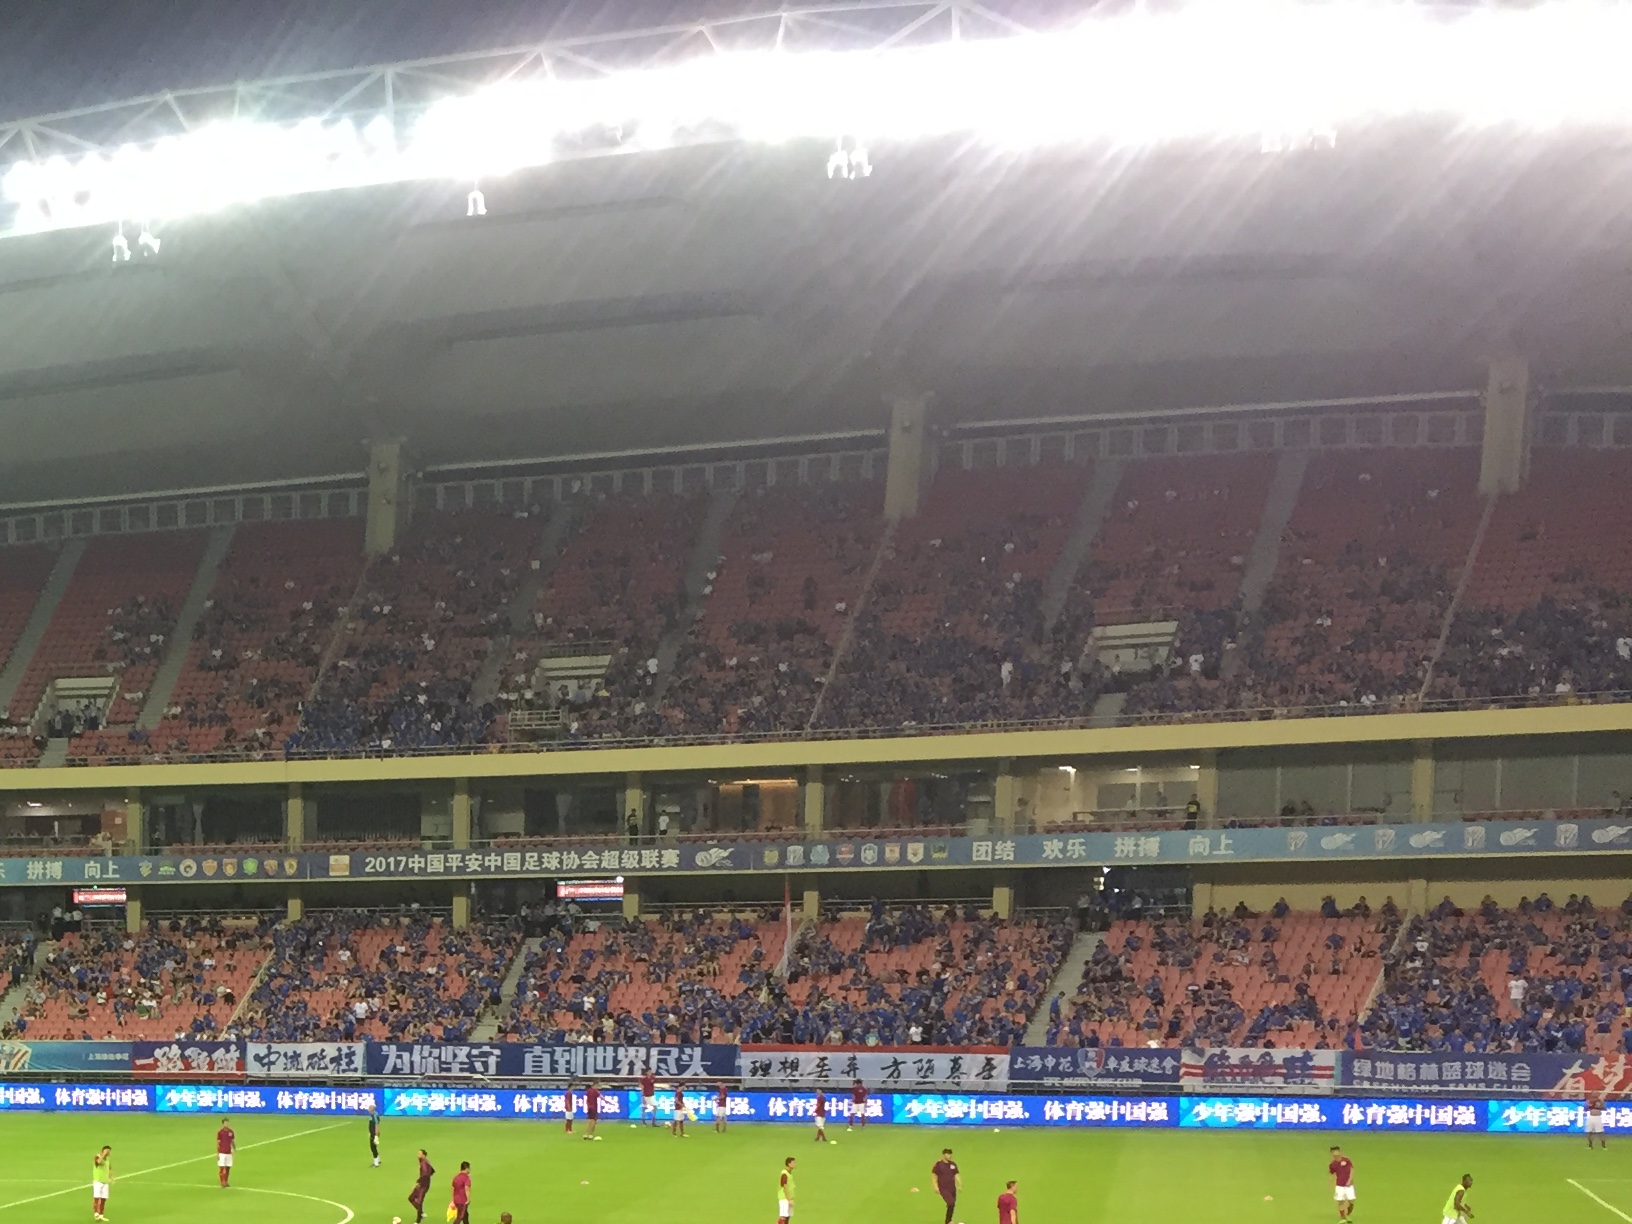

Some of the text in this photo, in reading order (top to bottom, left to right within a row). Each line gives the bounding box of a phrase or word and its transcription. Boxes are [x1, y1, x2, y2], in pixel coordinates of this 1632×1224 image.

[972, 834, 1234, 862] 团结 欢乐 拼搏 向上
[27, 860, 62, 880] 拼搏
[85, 860, 119, 880] 向上
[365, 849, 679, 873] 2017中国平安中国足球协会超级联赛
[252, 1043, 359, 1075] 中流砥柱
[381, 1045, 711, 1077] 为你坚守 直到世界尽头
[1014, 1054, 1074, 1072] 上海申花
[1343, 1103, 1477, 1126] 体育强中国强
